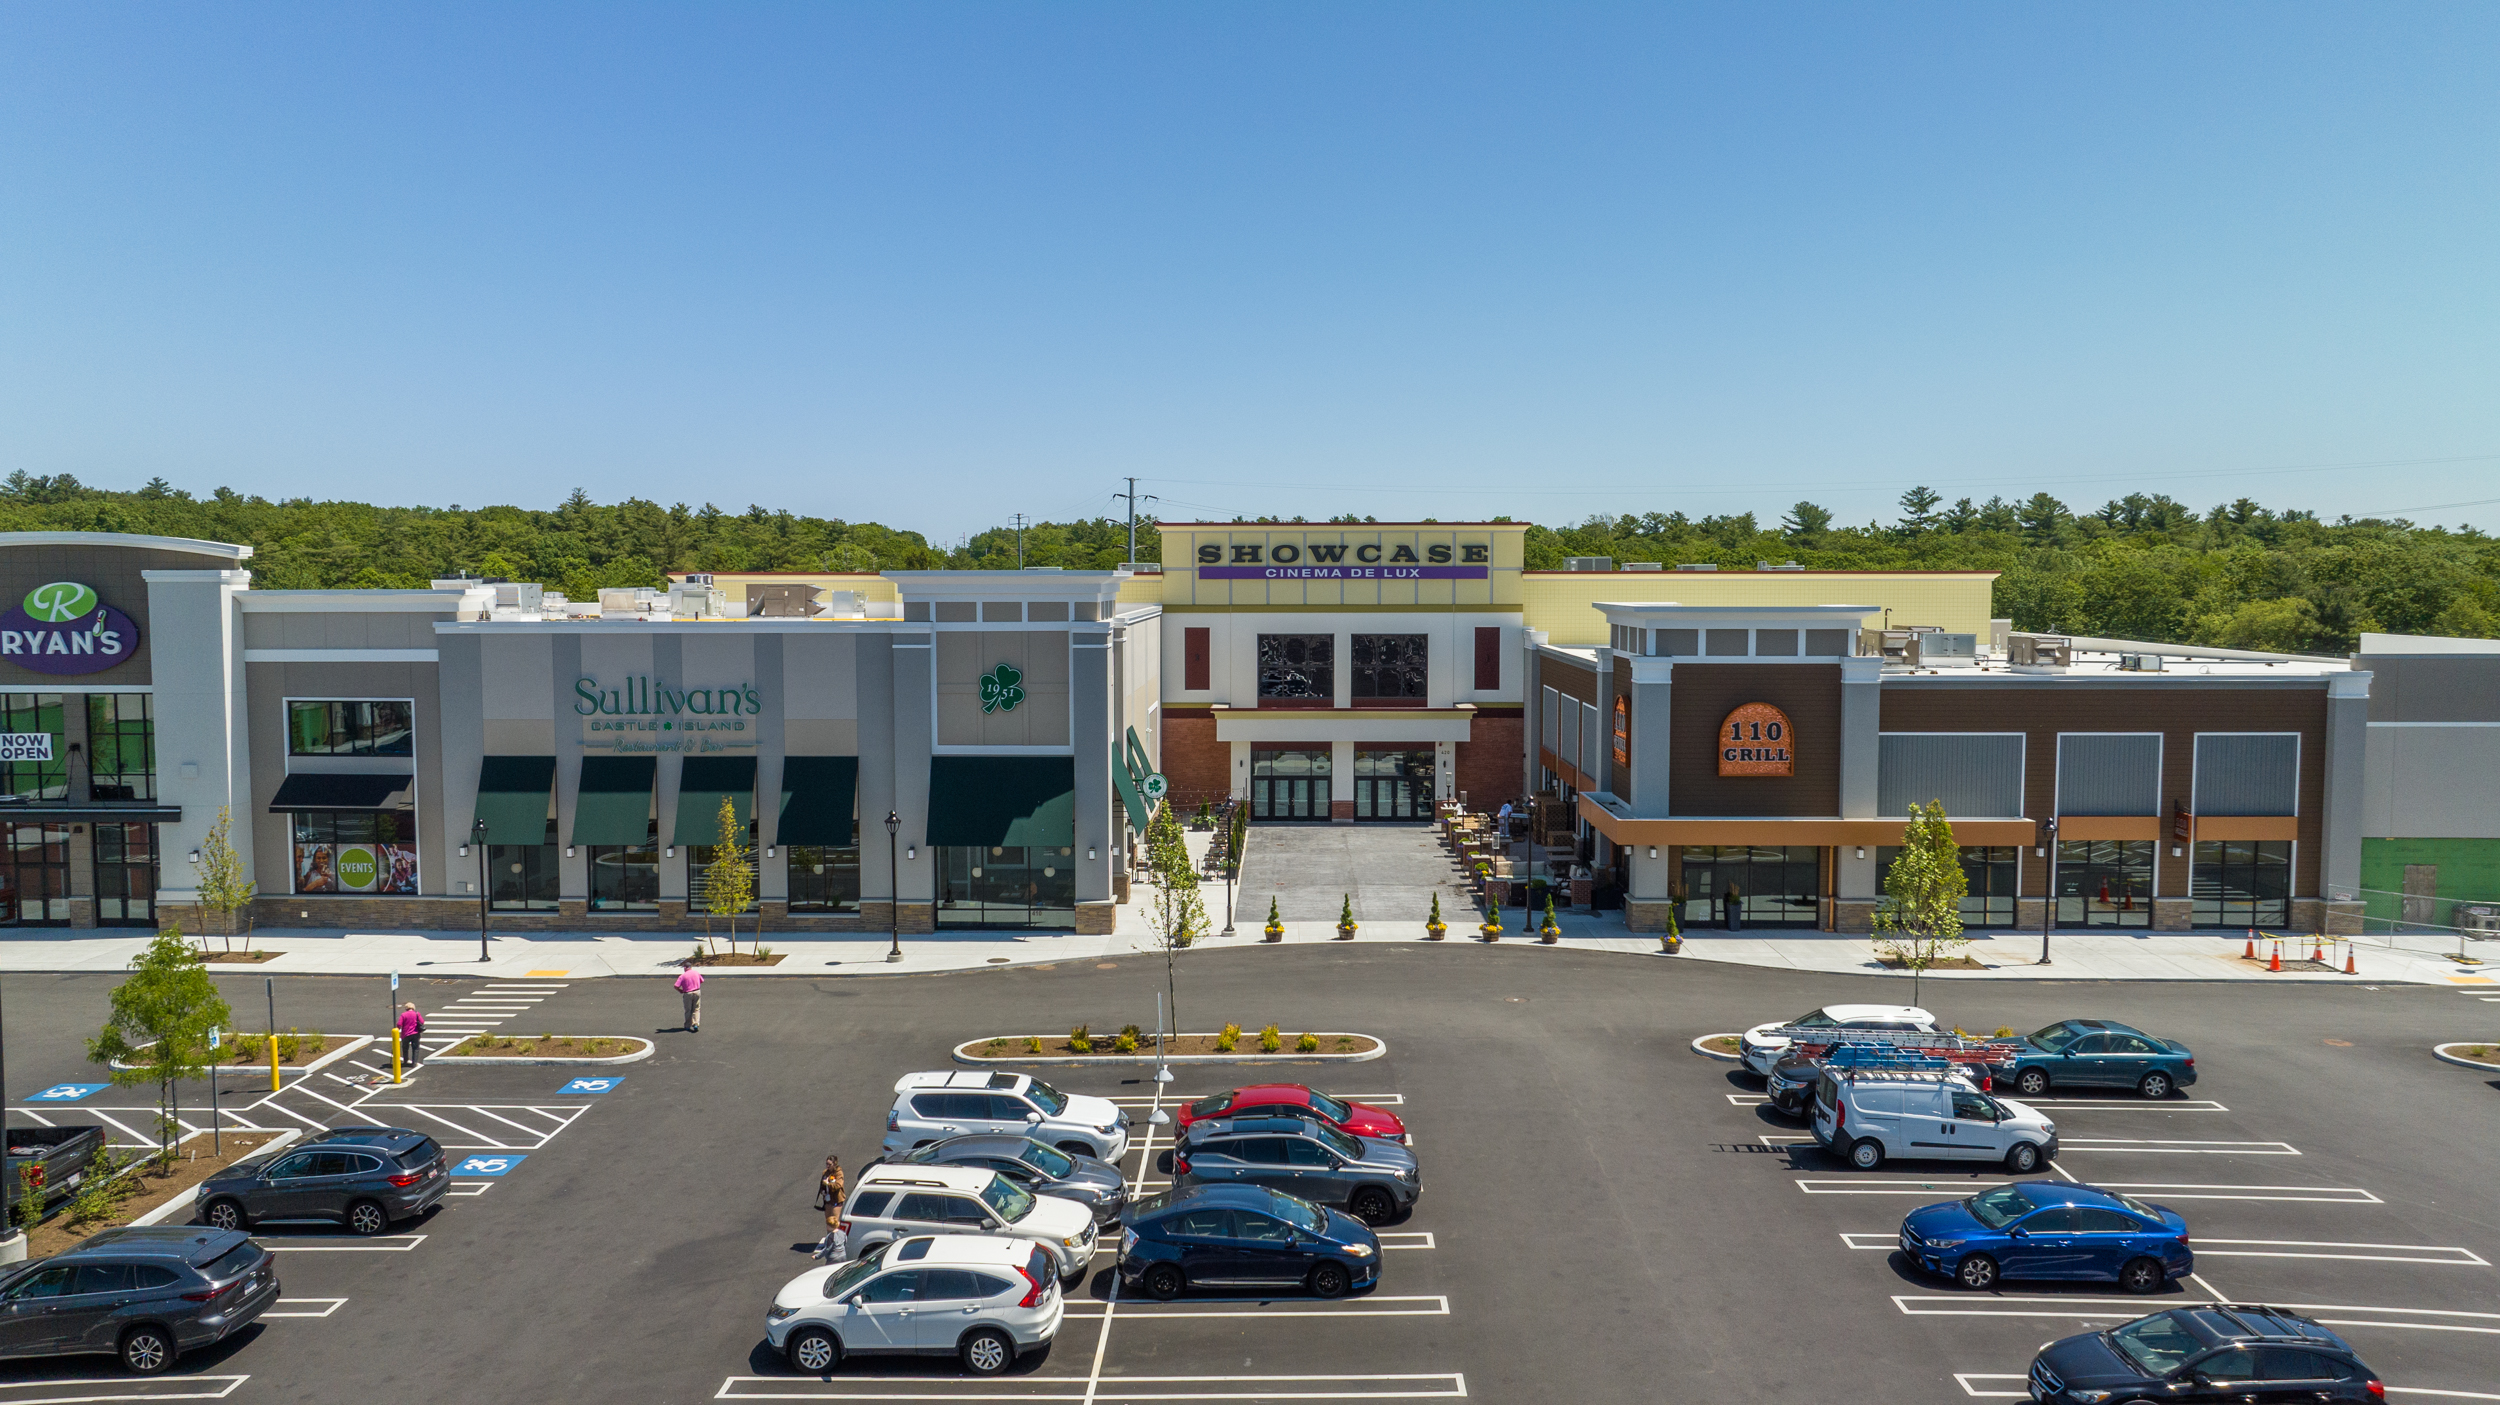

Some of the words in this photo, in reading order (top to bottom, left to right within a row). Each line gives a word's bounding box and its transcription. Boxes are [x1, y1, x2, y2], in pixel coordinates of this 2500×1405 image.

[1198, 545, 1489, 563] SHOWCASE
[1265, 568, 1342, 578] CINEMA
[1350, 568, 1375, 578] DE
[1384, 568, 1421, 578] LUX
[1, 611, 122, 655] RYAN'S
[574, 676, 762, 716] Sullivan's
[591, 721, 659, 731] CASTLE
[678, 721, 746, 731] ISLAND
[1730, 721, 1783, 742] 110
[2, 734, 44, 747] NOW
[613, 738, 681, 753] Restaurant
[685, 738, 696, 752] &
[700, 739, 725, 753] Bar
[1, 747, 49, 759] OPEN
[1723, 747, 1790, 762] GRILL
[340, 862, 374, 873] EVENTS
